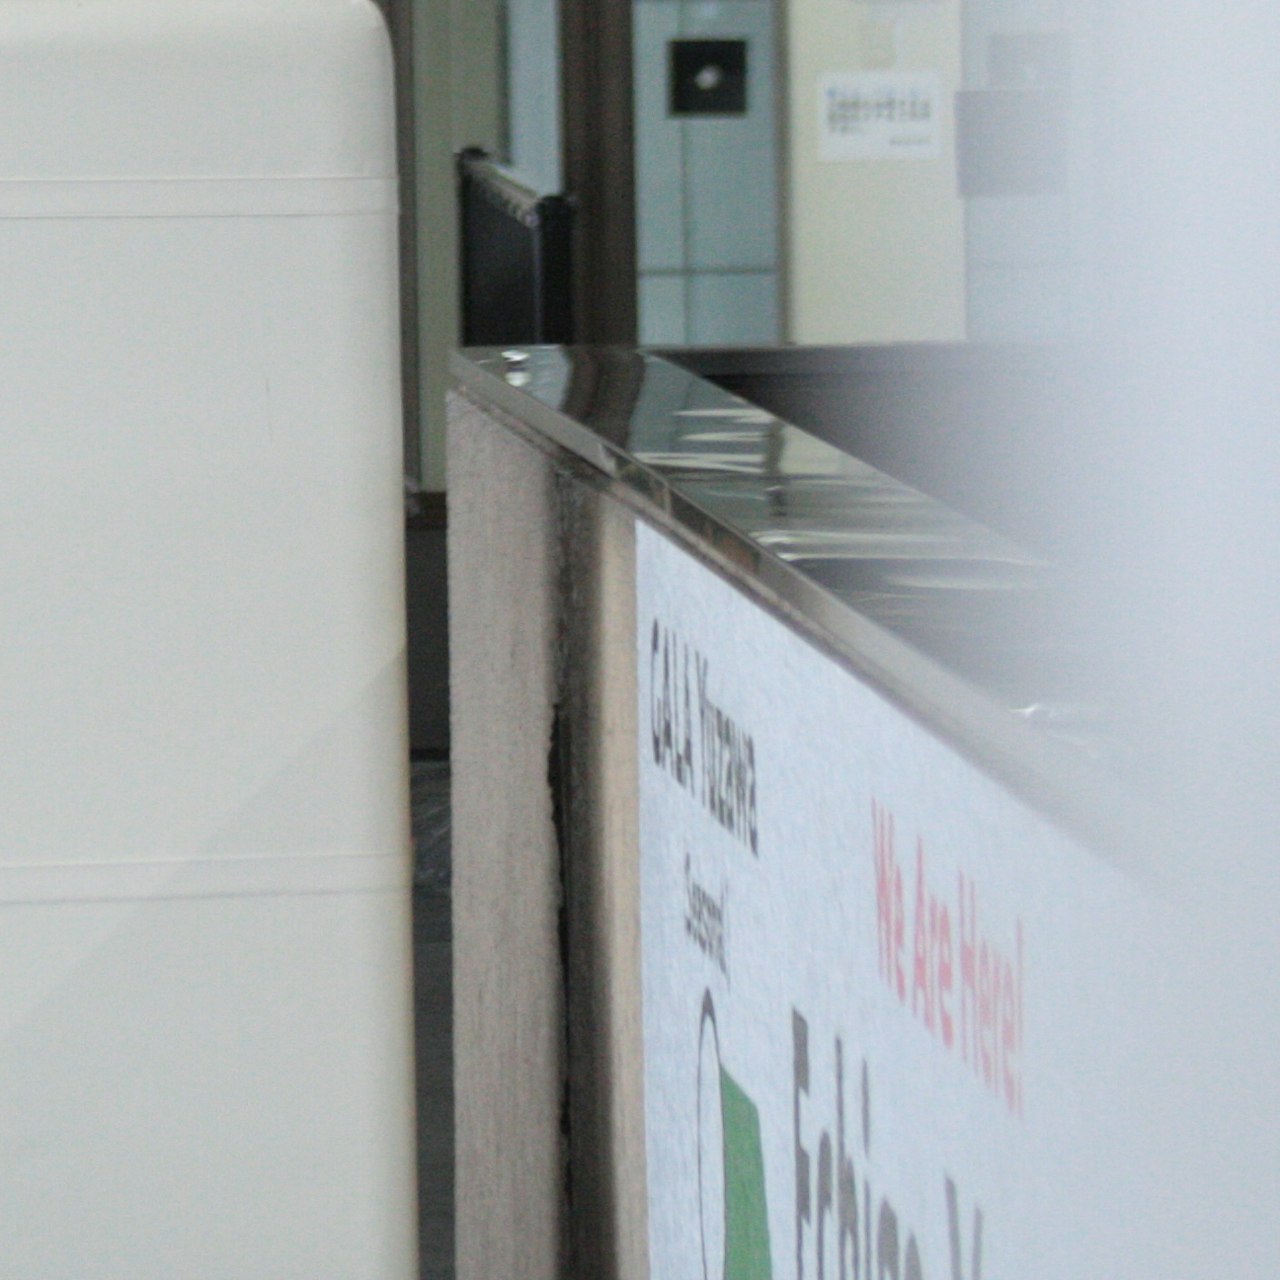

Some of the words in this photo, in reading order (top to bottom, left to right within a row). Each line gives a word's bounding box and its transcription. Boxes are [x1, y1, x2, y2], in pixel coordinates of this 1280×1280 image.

[871, 794, 905, 1001] We
[912, 833, 953, 1049] Are
[958, 869, 1024, 1120] Here!
